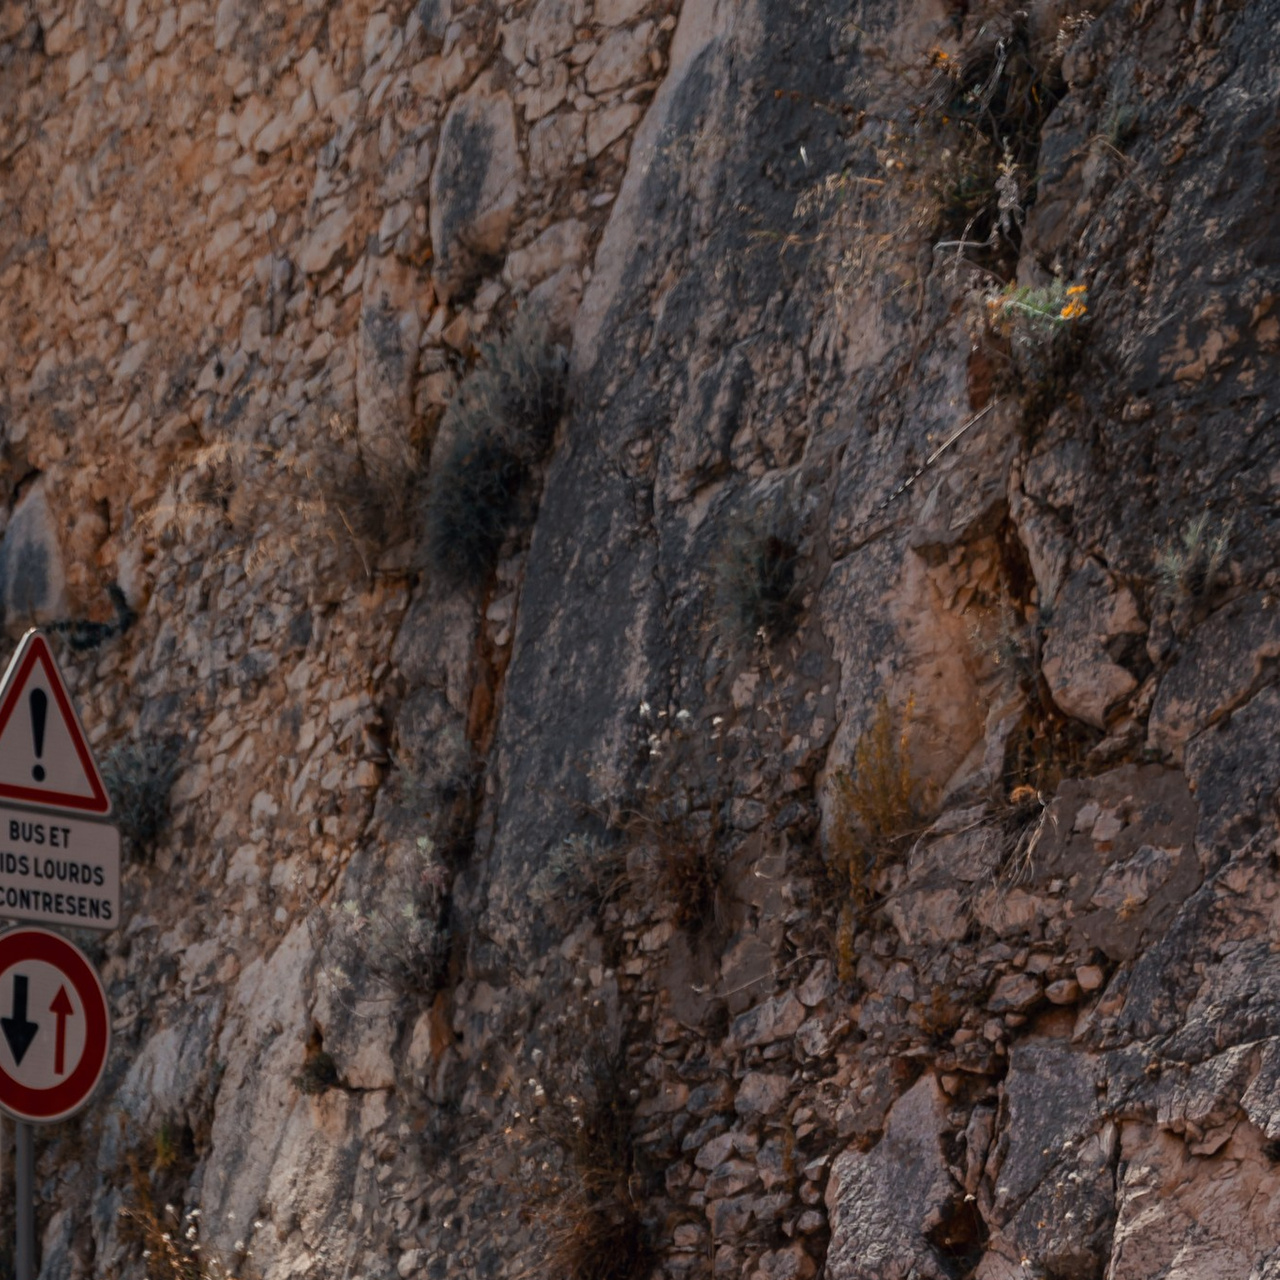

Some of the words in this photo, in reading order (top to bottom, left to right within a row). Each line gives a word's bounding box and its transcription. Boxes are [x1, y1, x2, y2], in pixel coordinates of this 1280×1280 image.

[9, 820, 45, 845] BUS
[50, 826, 71, 848] ET
[34, 857, 104, 886] LOURDS
